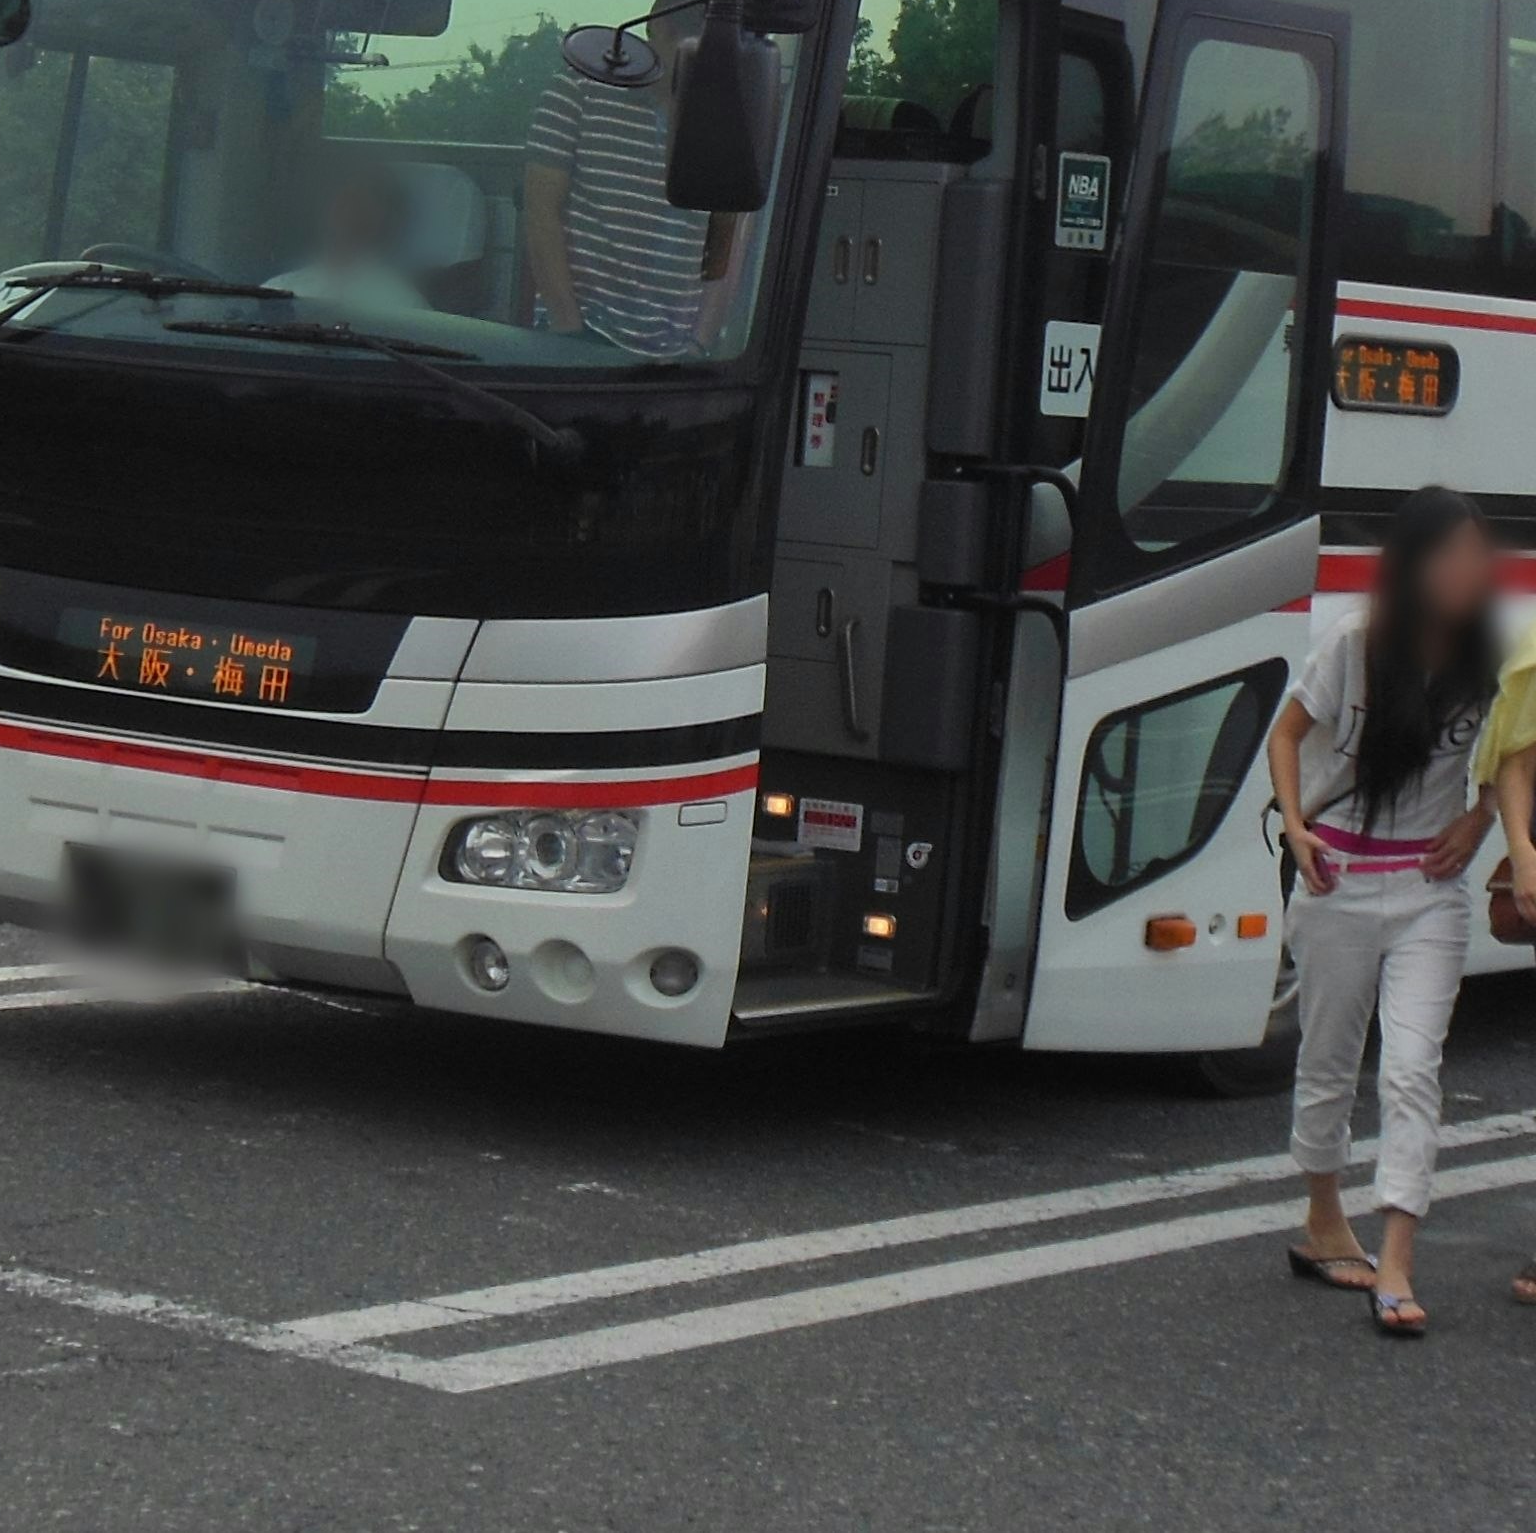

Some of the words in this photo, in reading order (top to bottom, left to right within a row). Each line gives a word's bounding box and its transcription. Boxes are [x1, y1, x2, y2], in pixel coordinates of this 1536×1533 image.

[1068, 174, 1099, 197] NBA
[100, 617, 135, 641] For
[141, 622, 202, 650] Osaka
[230, 633, 292, 662] Umeda
[96, 641, 290, 703] 大阪・梅田
